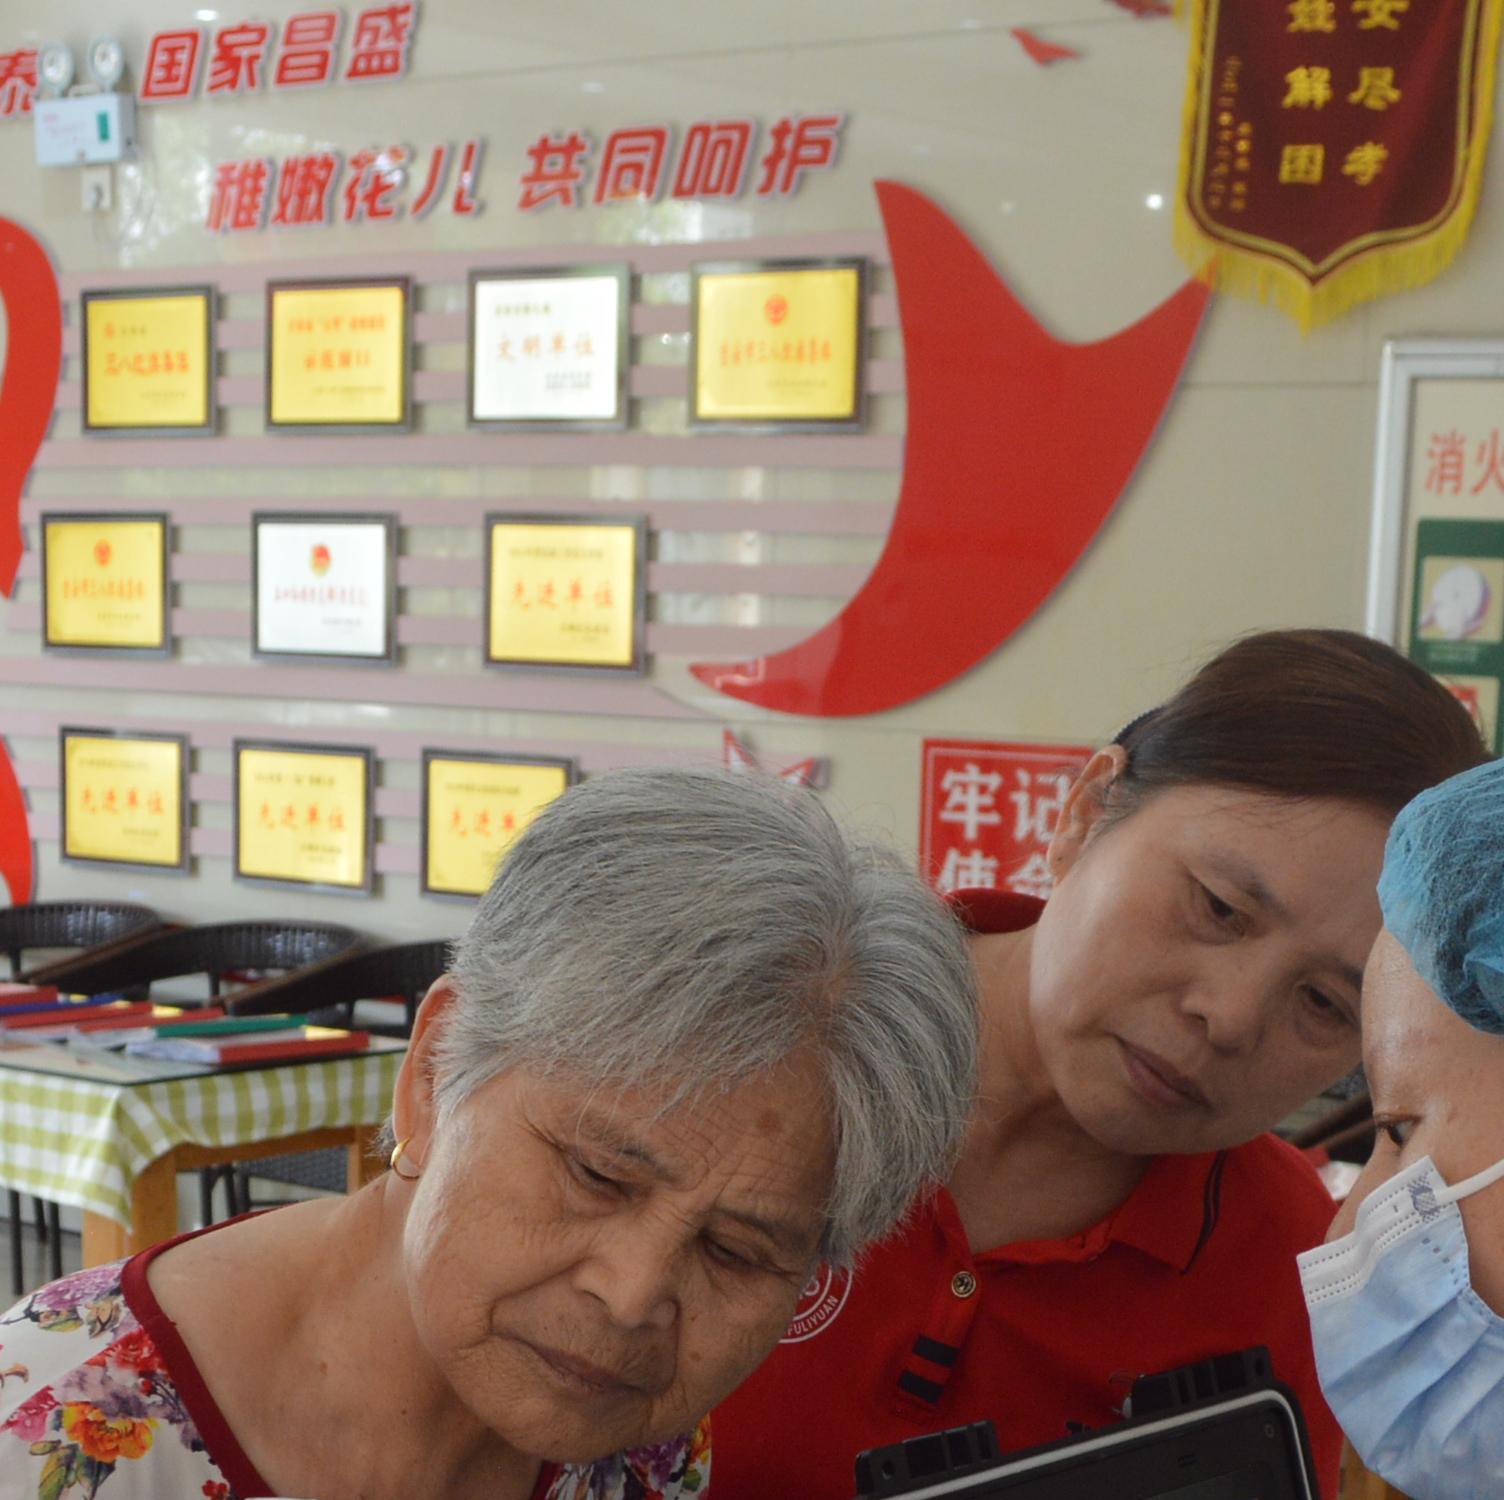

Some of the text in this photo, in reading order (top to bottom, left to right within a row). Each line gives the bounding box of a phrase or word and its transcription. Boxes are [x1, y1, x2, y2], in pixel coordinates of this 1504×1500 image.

[140, 2, 420, 100] 国家昌盛
[206, 115, 842, 232] 稚嫩花儿 共同呵护
[939, 762, 1073, 843] 牢记
